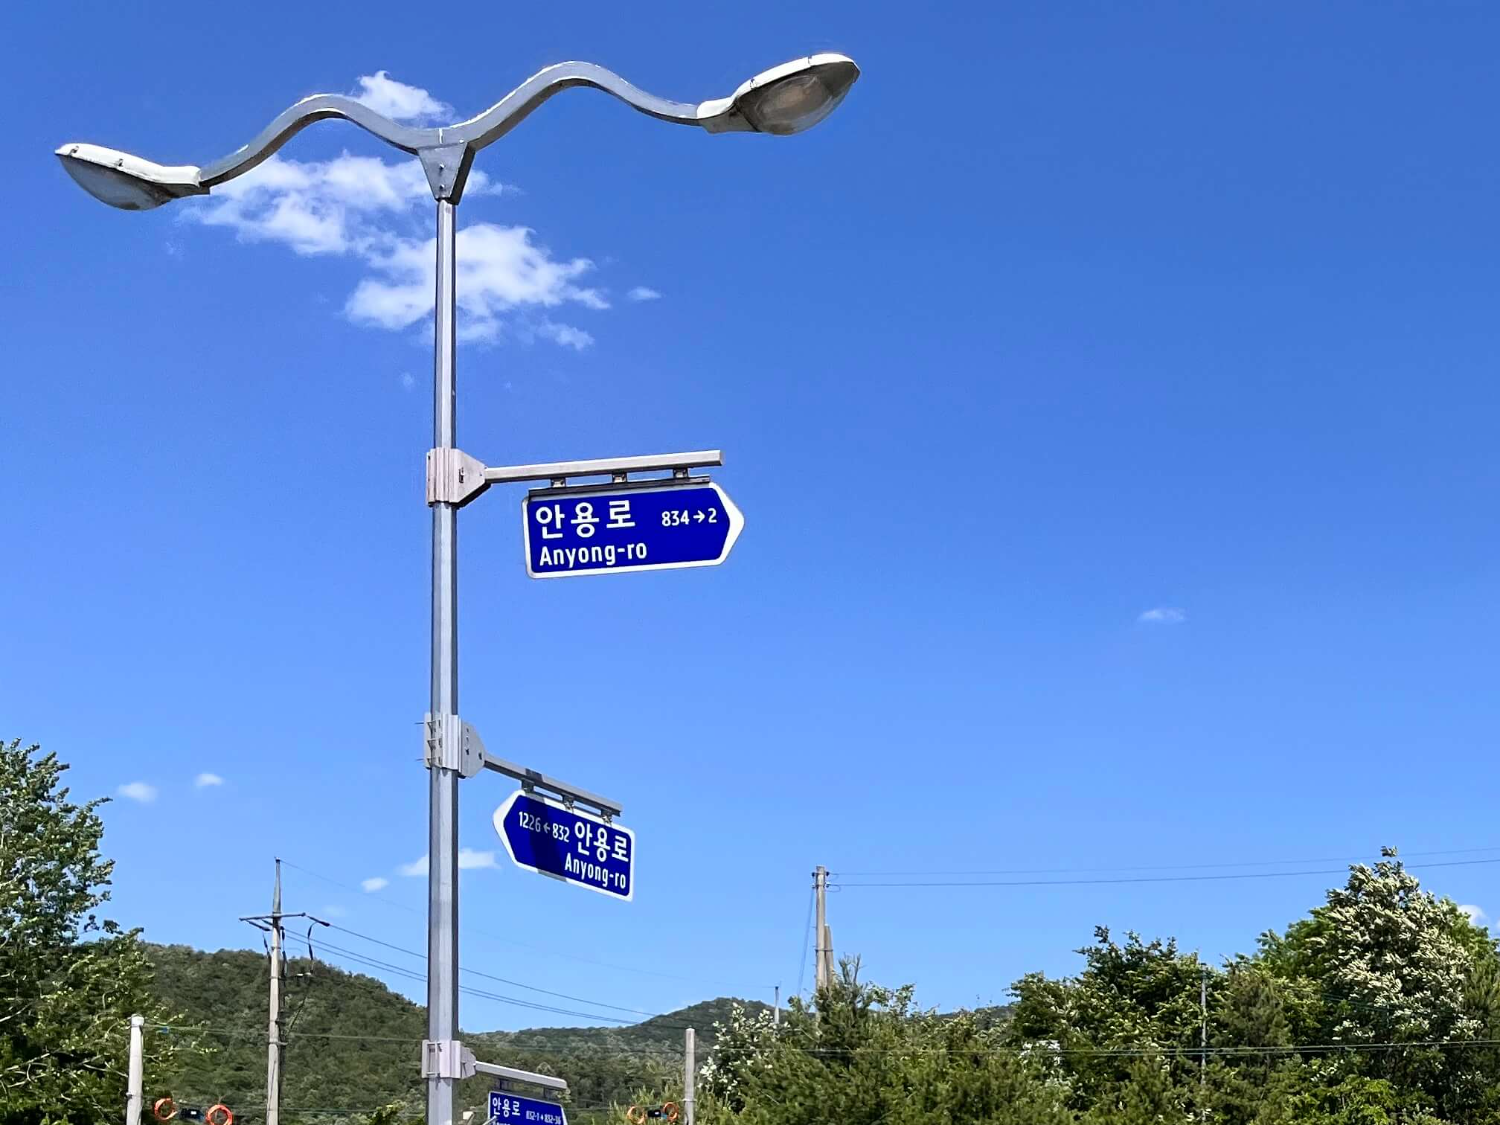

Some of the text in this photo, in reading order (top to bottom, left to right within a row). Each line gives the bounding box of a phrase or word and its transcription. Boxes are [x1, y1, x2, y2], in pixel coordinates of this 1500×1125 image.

[535, 499, 718, 540] 안용로 834 2
[539, 543, 647, 569] Anyong-ro
[518, 811, 629, 863] 1226 832 안용로
[564, 852, 627, 889] Anyong-ro
[492, 1097, 520, 1118] 안용로
